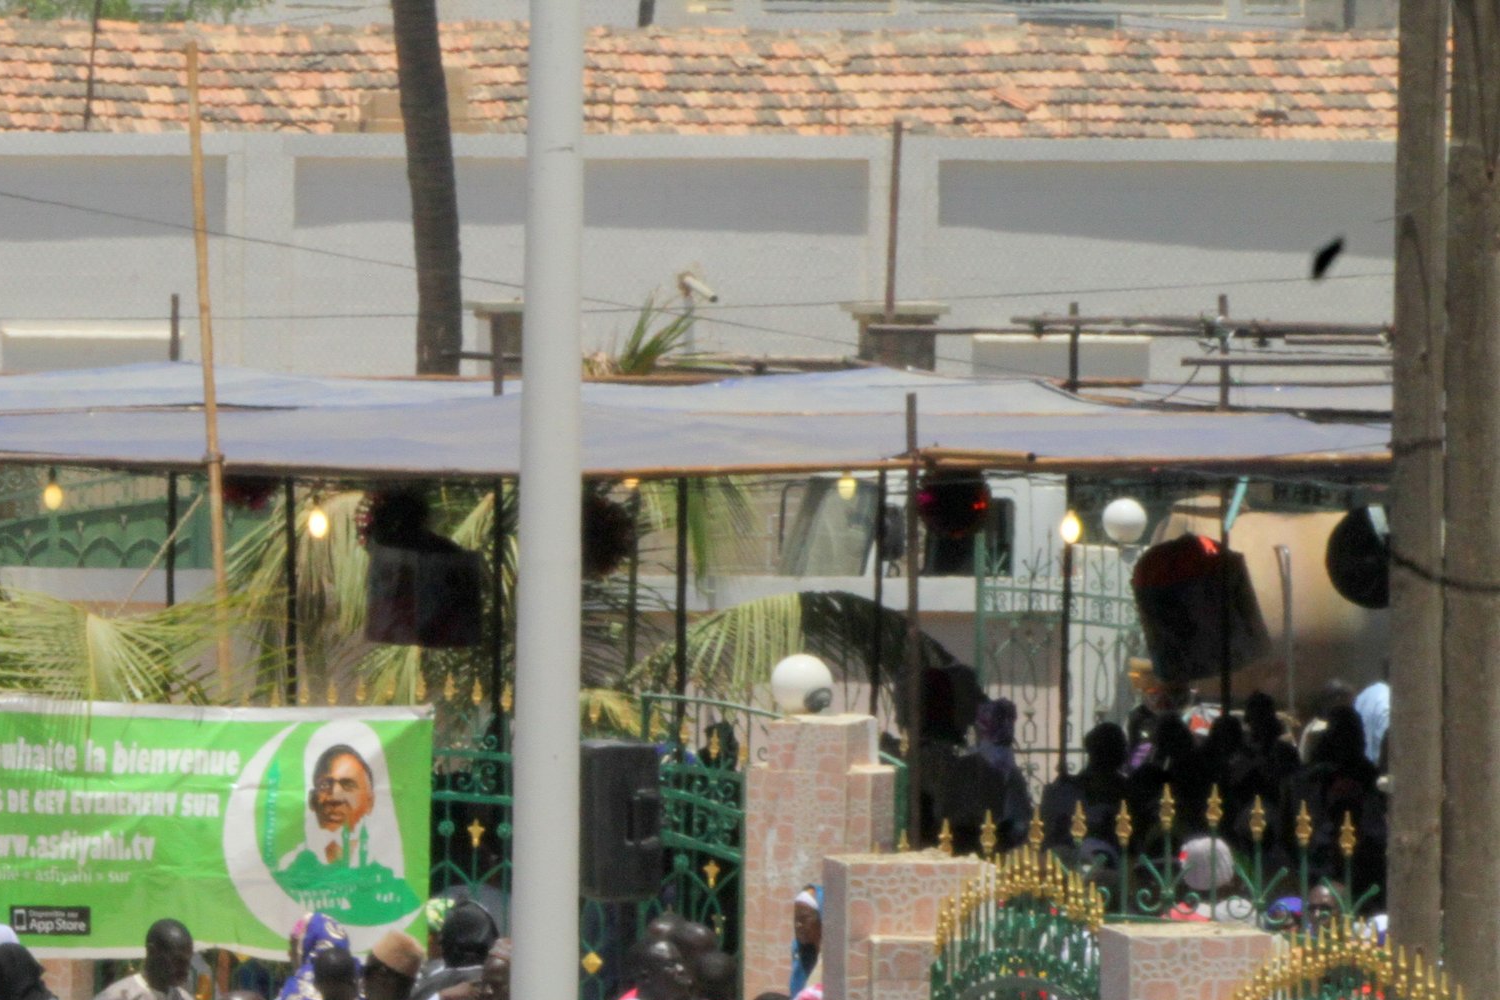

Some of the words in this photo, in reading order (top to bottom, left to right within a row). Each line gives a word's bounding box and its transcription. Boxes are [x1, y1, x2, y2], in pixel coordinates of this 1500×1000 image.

[84, 739, 107, 773] la
[112, 740, 241, 776] bienvenue
[7, 788, 29, 814] DE
[33, 789, 67, 815] CET
[181, 792, 220, 818] SUR
[108, 870, 130, 883] sur
[29, 918, 54, 934] App
[55, 918, 87, 932] Store
